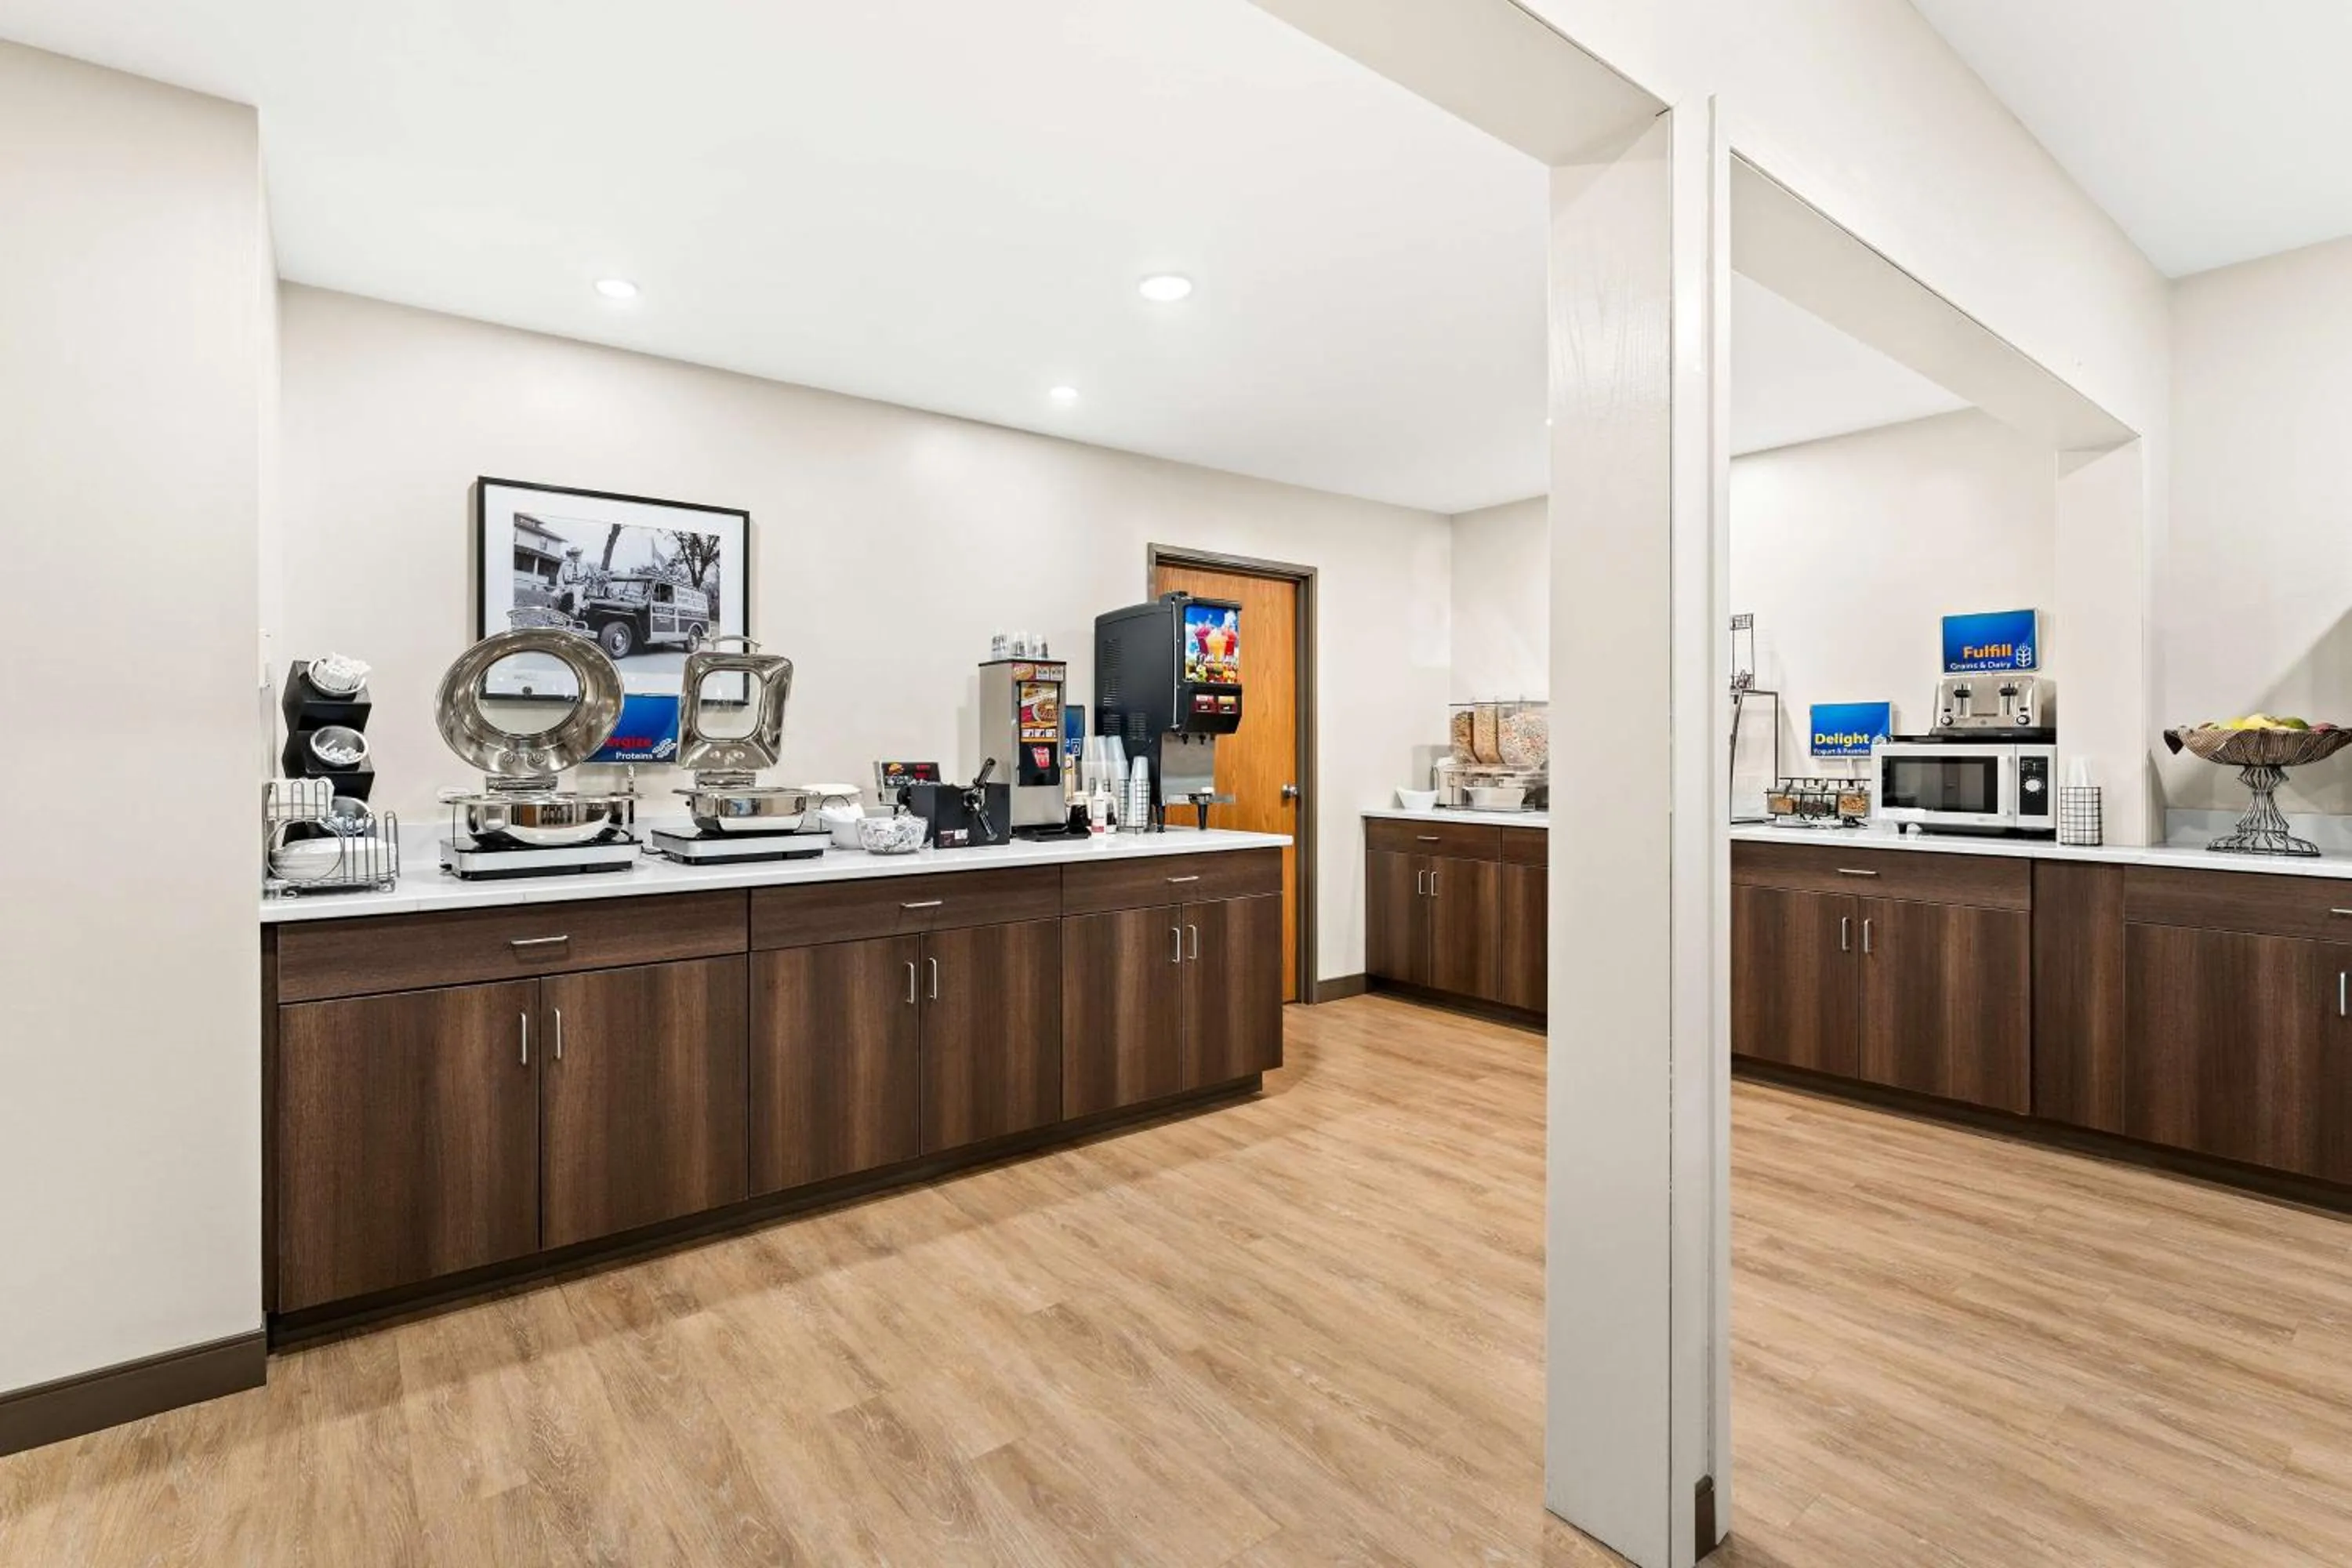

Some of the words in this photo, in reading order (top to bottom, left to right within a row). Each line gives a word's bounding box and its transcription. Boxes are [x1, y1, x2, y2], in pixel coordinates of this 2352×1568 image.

[1963, 644, 2013, 659] Fulfill
[1987, 660, 2012, 669] Dairy
[605, 736, 653, 750] ergize
[1815, 732, 1870, 747] Delight
[615, 751, 653, 760] Proteins
